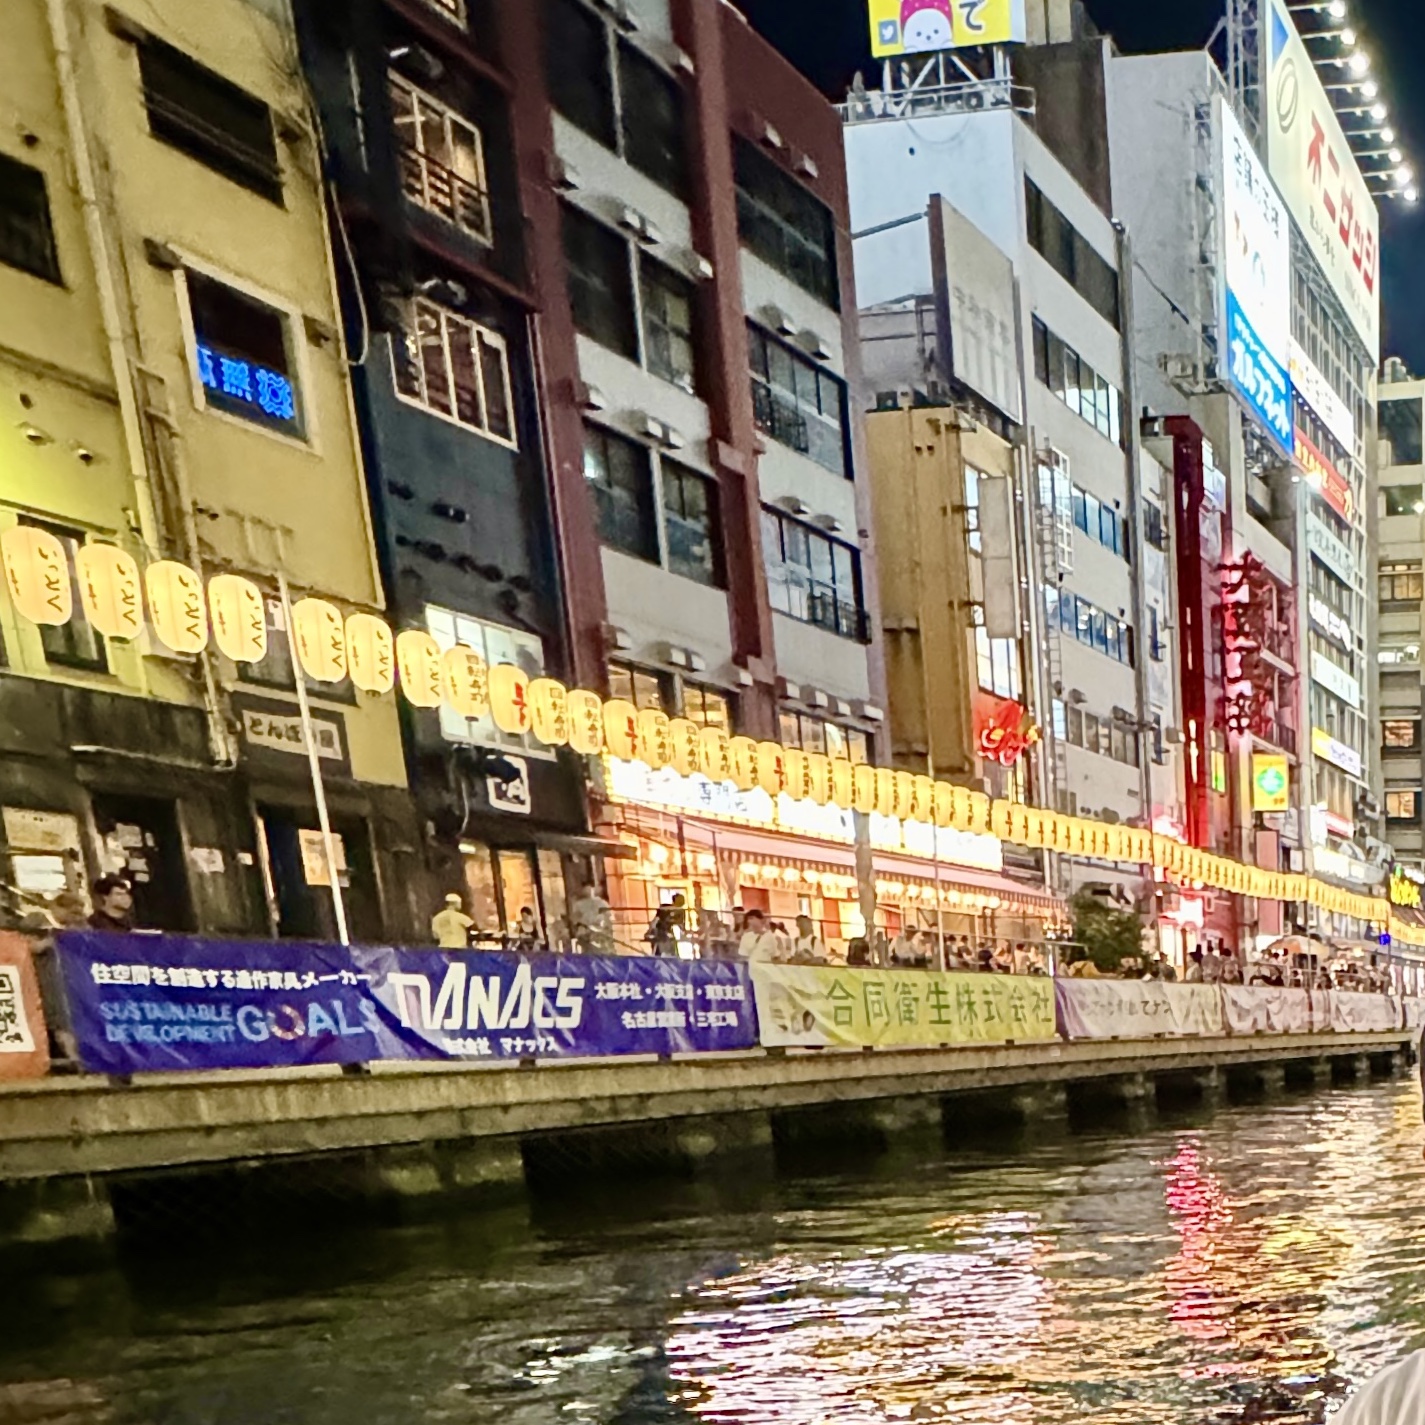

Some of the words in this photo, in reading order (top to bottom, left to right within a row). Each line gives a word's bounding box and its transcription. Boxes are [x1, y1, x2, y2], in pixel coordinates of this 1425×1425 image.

[98, 1001, 234, 1022] SUSTAINABLE
[826, 977, 1053, 1028] 合同衛生株式会社
[105, 1024, 237, 1044] DEVELOPMENT
